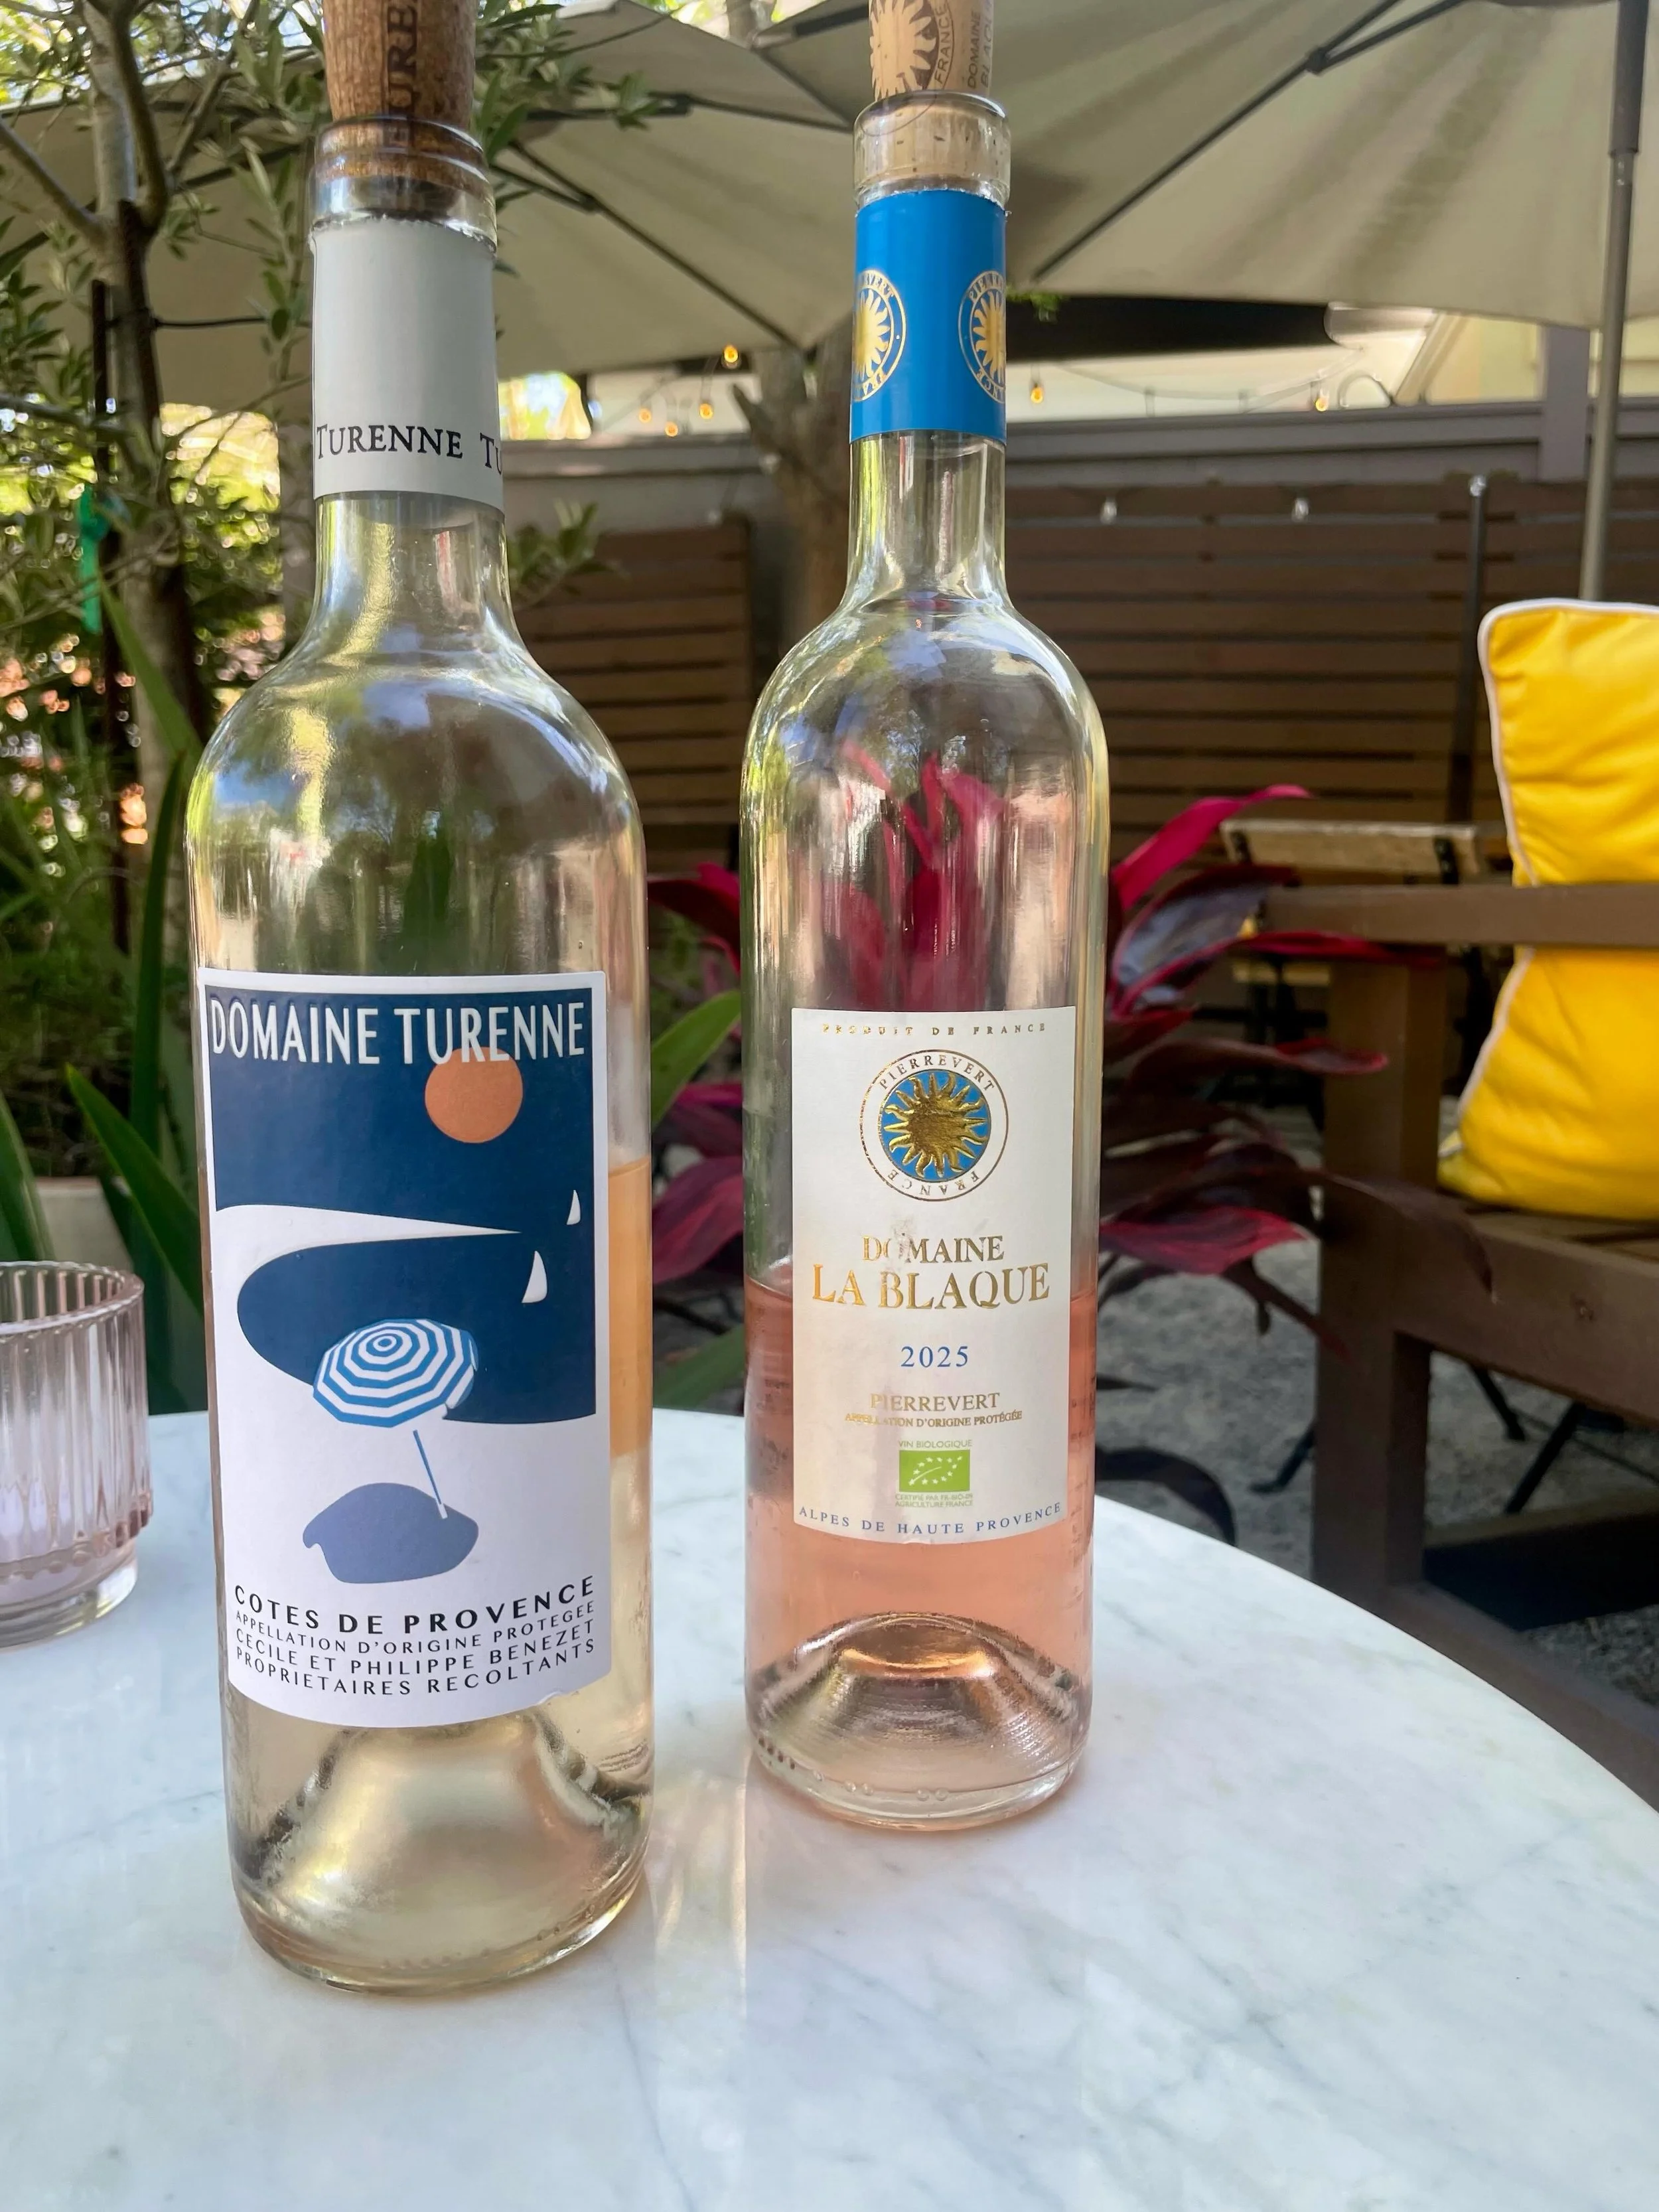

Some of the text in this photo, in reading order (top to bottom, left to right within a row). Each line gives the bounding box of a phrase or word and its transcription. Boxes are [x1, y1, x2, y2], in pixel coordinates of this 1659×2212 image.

[935, 1, 950, 84] FRANCE
[968, 11, 981, 89] DOMAINE
[317, 424, 463, 459] TURENNE
[211, 998, 585, 1065] DOMAINE TURENNE
[822, 1022, 1046, 1035] PRODUIT DE FRANCE
[879, 1054, 995, 1092] PIERREVERT
[887, 1169, 981, 1196] FRANCE
[812, 1262, 1050, 1309] LA BLAQUE
[900, 1345, 969, 1368] 2025
[871, 1392, 1000, 1412] PIERREVERT
[916, 1416, 971, 1427] D'ORIGINE
[974, 1410, 1023, 1426] PROTÉGÉE
[916, 1439, 972, 1448] BIOLOGIQUE
[799, 1502, 1060, 1534] ALPES DE HAUTE PROVENCE
[234, 1575, 594, 1635] COTES DE PROVENCE
[236, 1600, 595, 1654] APPELLATION D'ORIGINE PROTEGEE
[236, 1619, 595, 1675] CECILE ET PHILIPPE BENEZET
[236, 1638, 595, 1696] PROPRIETAIRES RECOLTANTS
